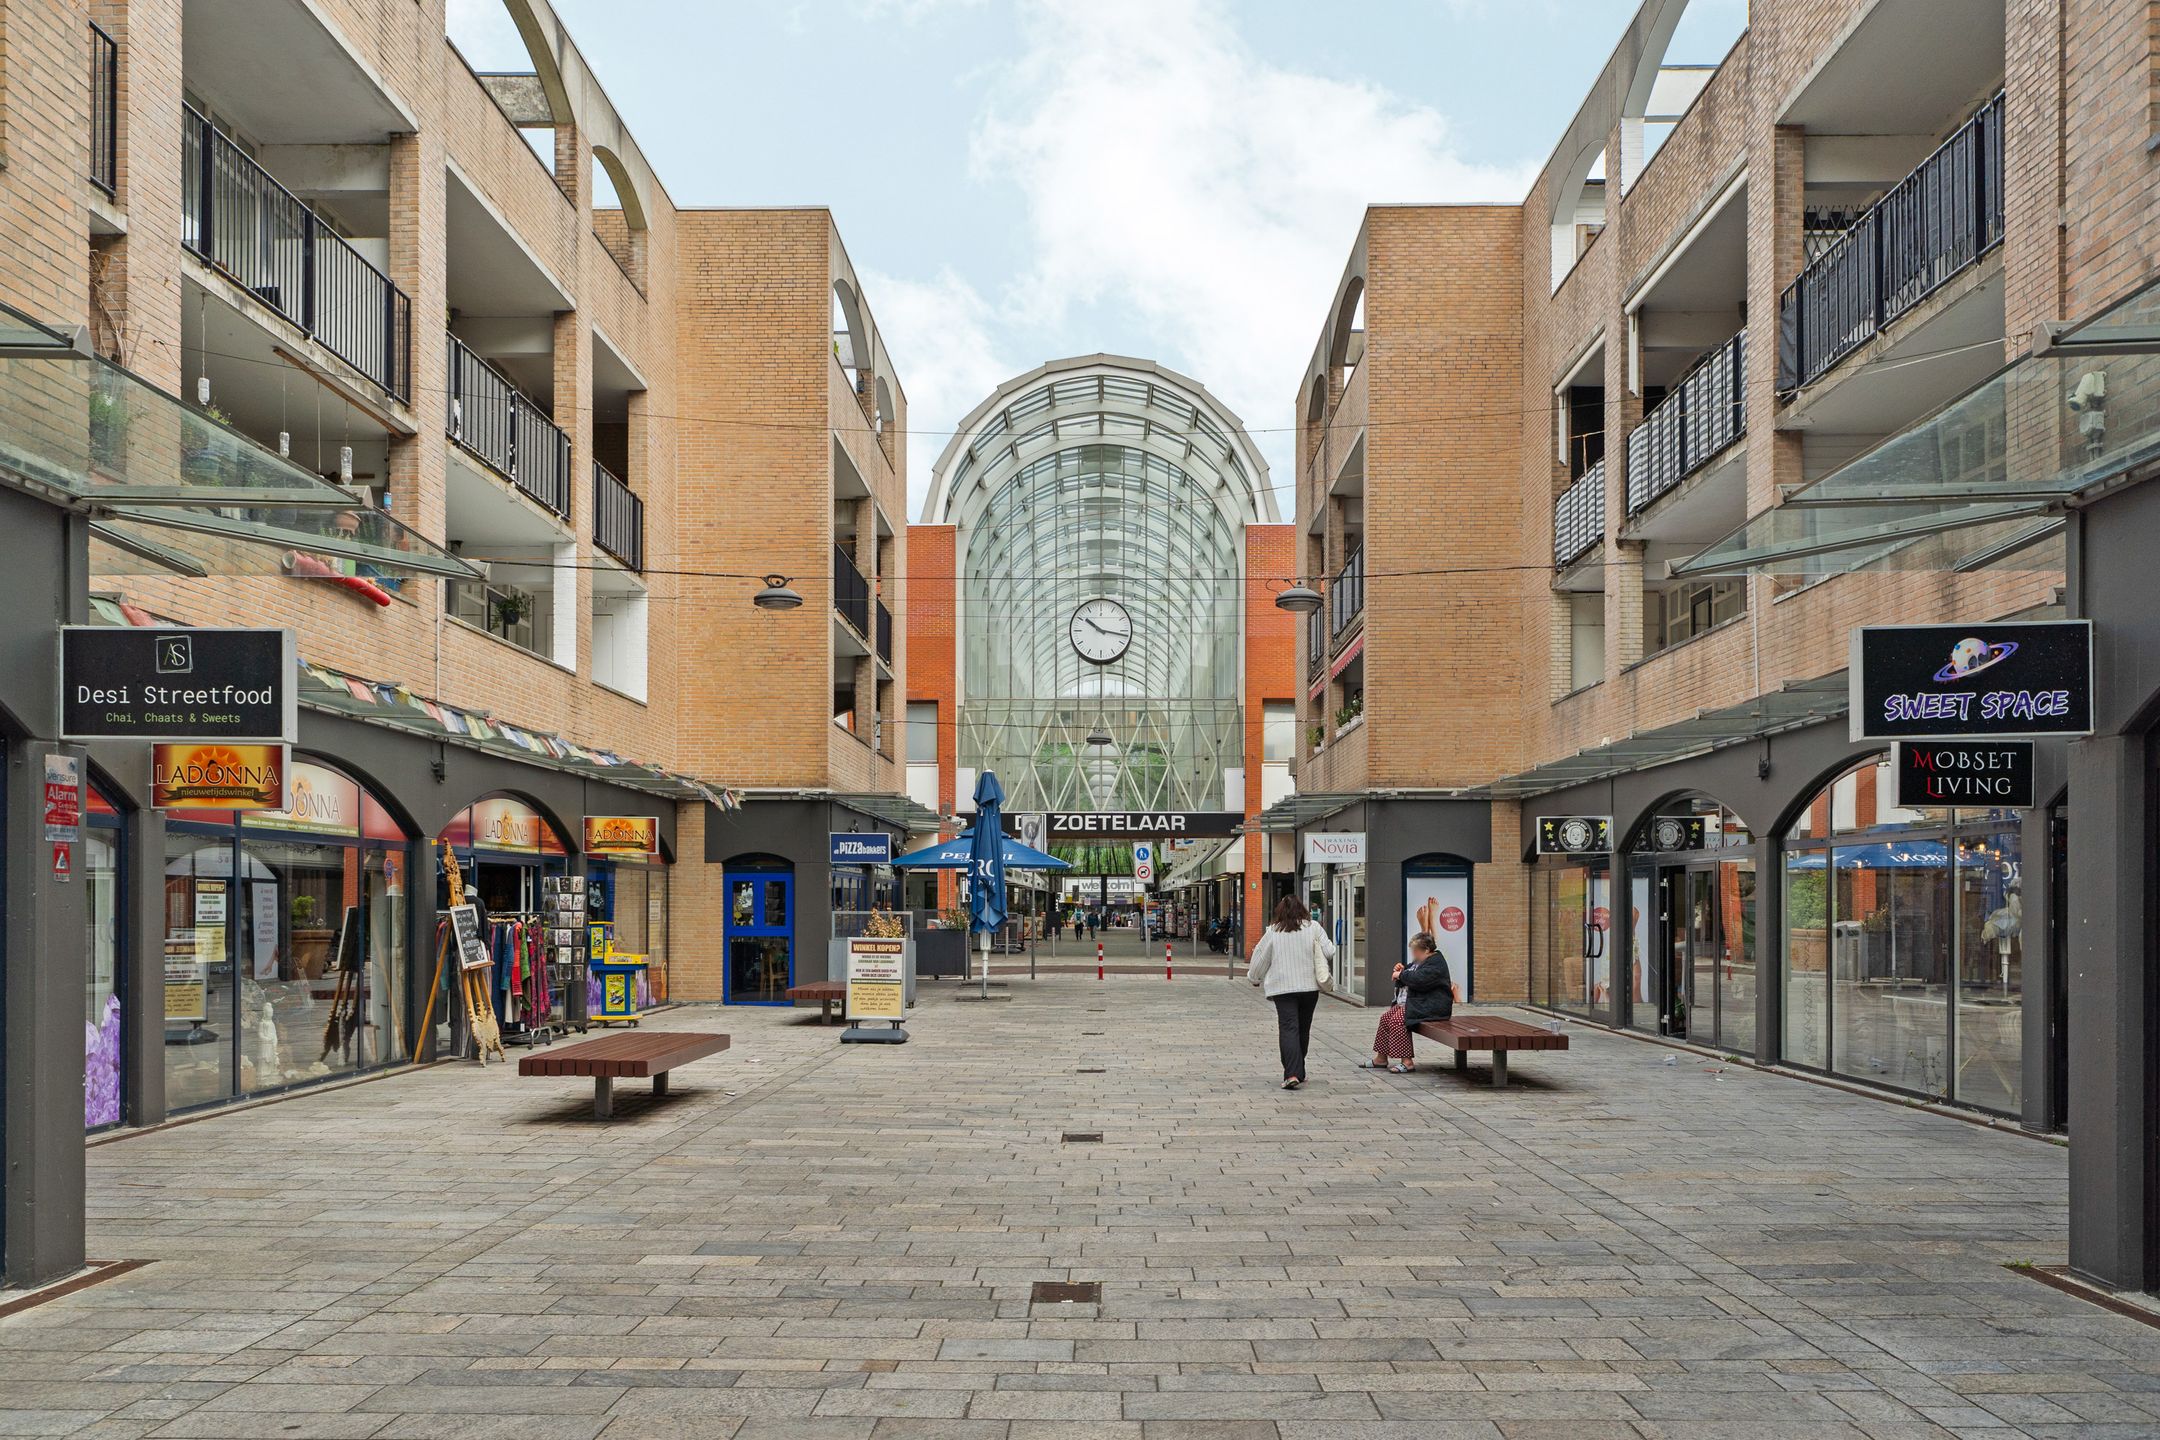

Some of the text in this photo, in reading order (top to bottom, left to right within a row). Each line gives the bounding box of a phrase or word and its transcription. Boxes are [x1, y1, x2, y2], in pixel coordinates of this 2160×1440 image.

[78, 685, 272, 704] Desi Streetfood
[1884, 690, 2069, 721] SWEET SPACE
[106, 712, 241, 723] Chai, Chaats & Sweets
[1912, 749, 2016, 772] MOBSET
[157, 763, 279, 786] LADONNA
[48, 785, 77, 801] Alarm
[181, 787, 254, 797] nieuwetijdswinkel
[1926, 775, 2012, 798] LIVING
[1053, 815, 1186, 831] ZOETELAAR
[586, 827, 654, 841] LADONNA
[1312, 838, 1358, 854] Novia
[853, 943, 900, 952] WINKEL KOPEN?
